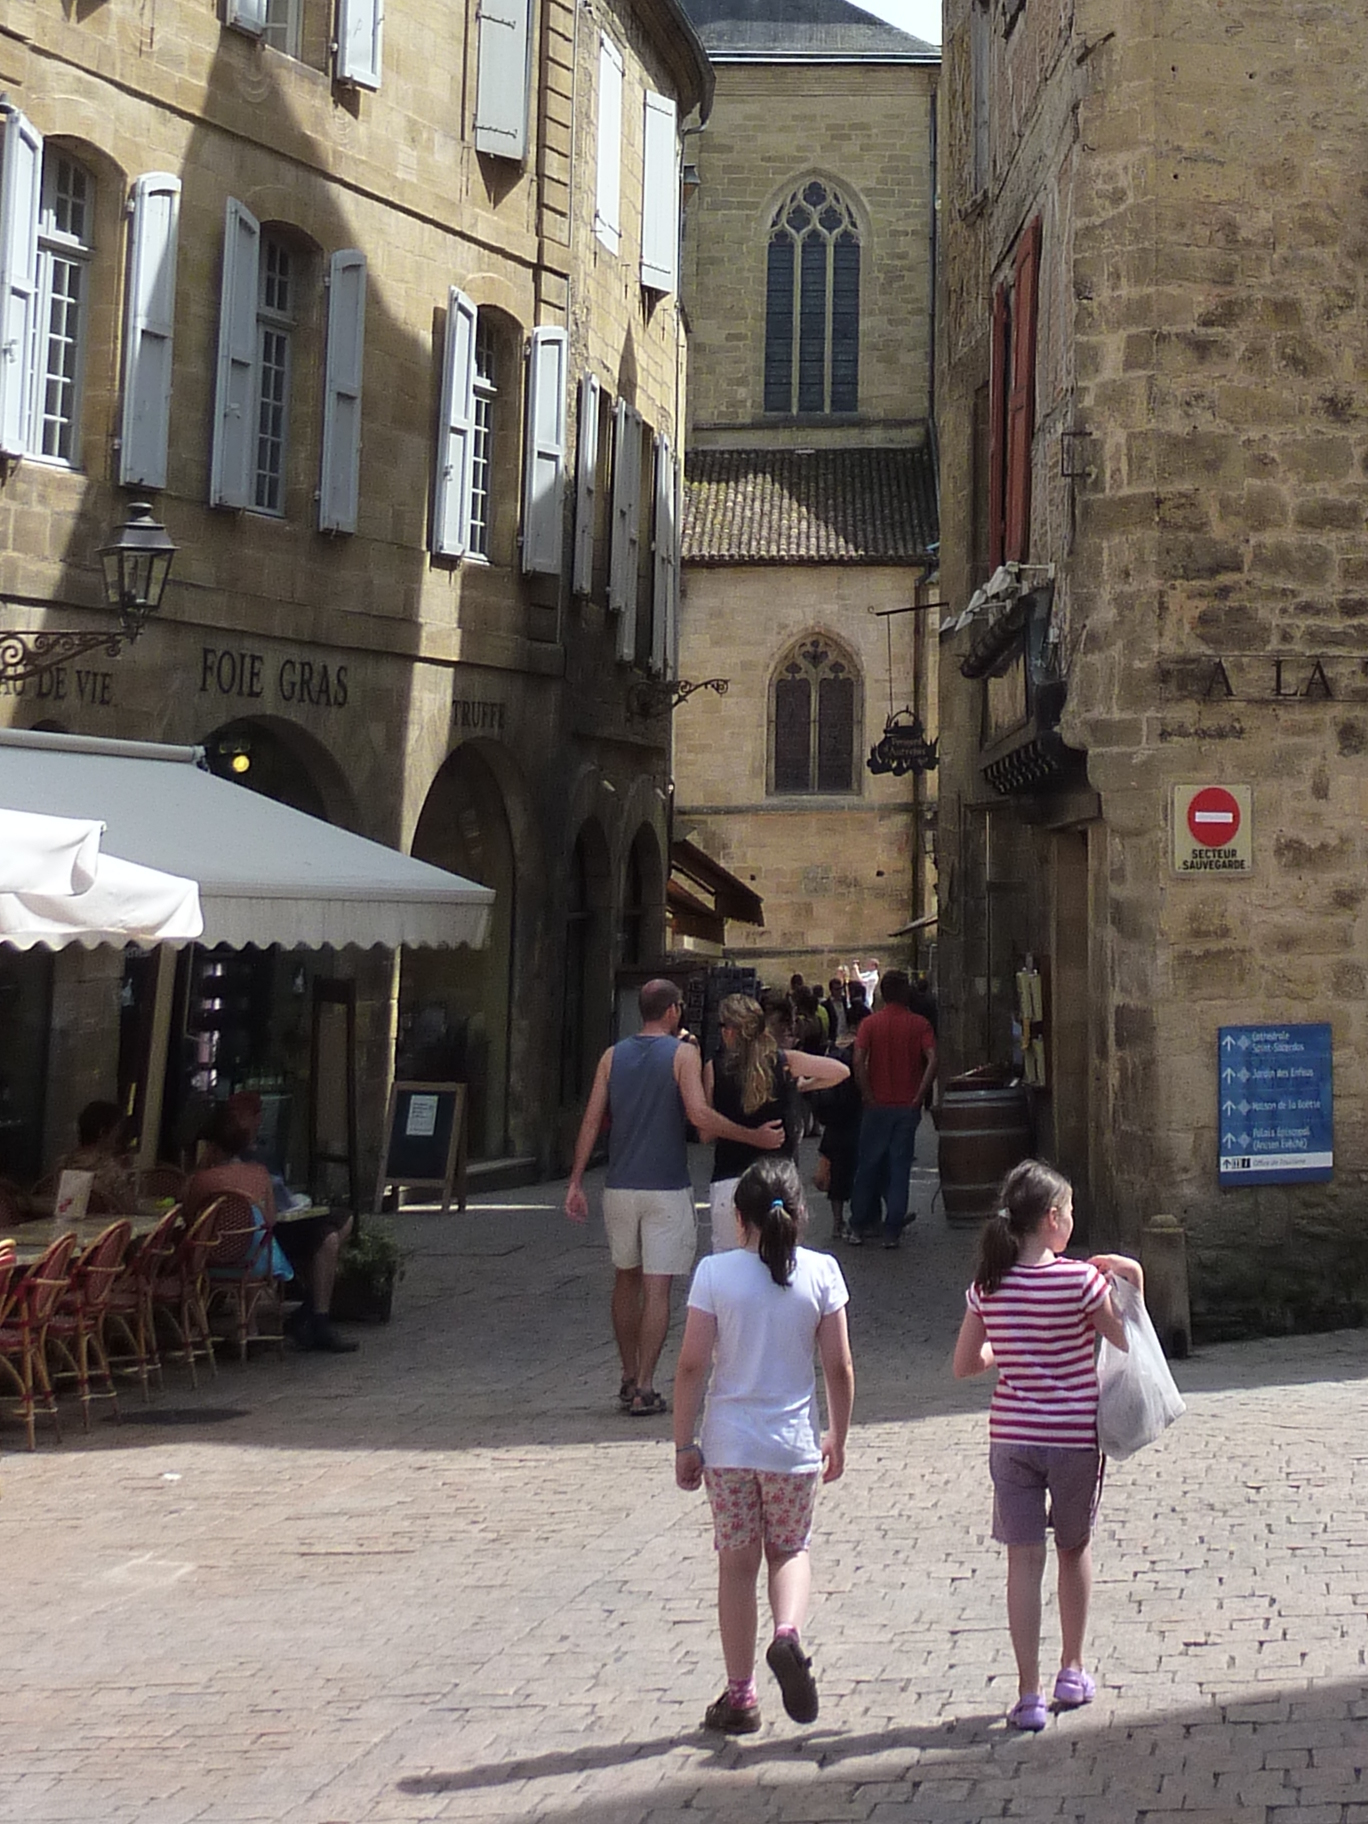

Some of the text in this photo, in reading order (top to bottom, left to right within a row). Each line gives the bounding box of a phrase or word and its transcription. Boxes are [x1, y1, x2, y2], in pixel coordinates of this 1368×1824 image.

[36, 667, 67, 700] DE
[75, 670, 113, 705] VIE
[200, 647, 348, 708] FOIE GRAS
[1203, 658, 1236, 698] A
[1271, 659, 1334, 699] LA
[1182, 859, 1246, 871] SAUVEGARDE
[1191, 848, 1238, 859] SECTEUR
